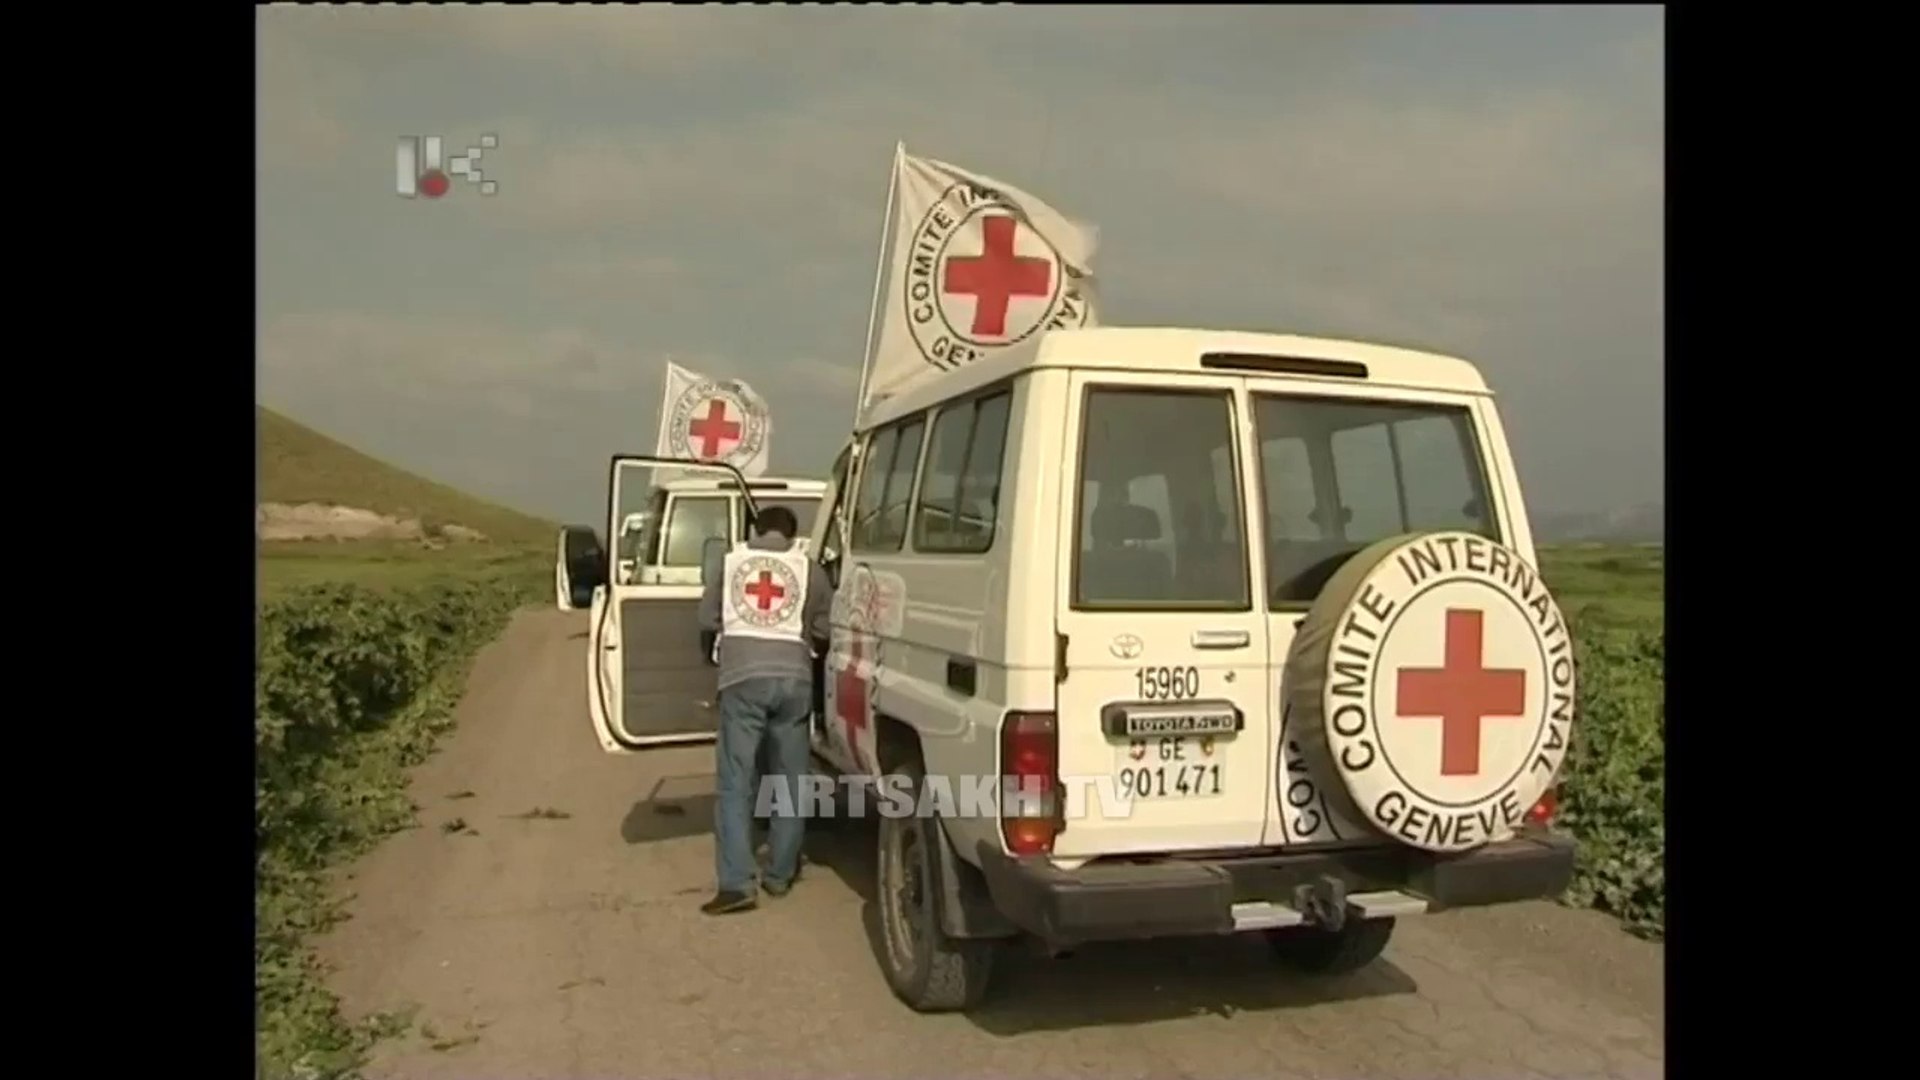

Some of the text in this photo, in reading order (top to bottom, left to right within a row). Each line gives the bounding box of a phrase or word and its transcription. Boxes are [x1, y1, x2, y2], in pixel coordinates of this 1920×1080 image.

[1331, 536, 1572, 775] COMITE INTERNATIONAL
[1135, 666, 1199, 699] 15960
[1132, 716, 1190, 731] TOYOTA
[1159, 736, 1186, 760] GE
[1121, 764, 1221, 797] 901 471
[1288, 740, 1321, 837] COM
[1375, 789, 1520, 846] GENEVE
